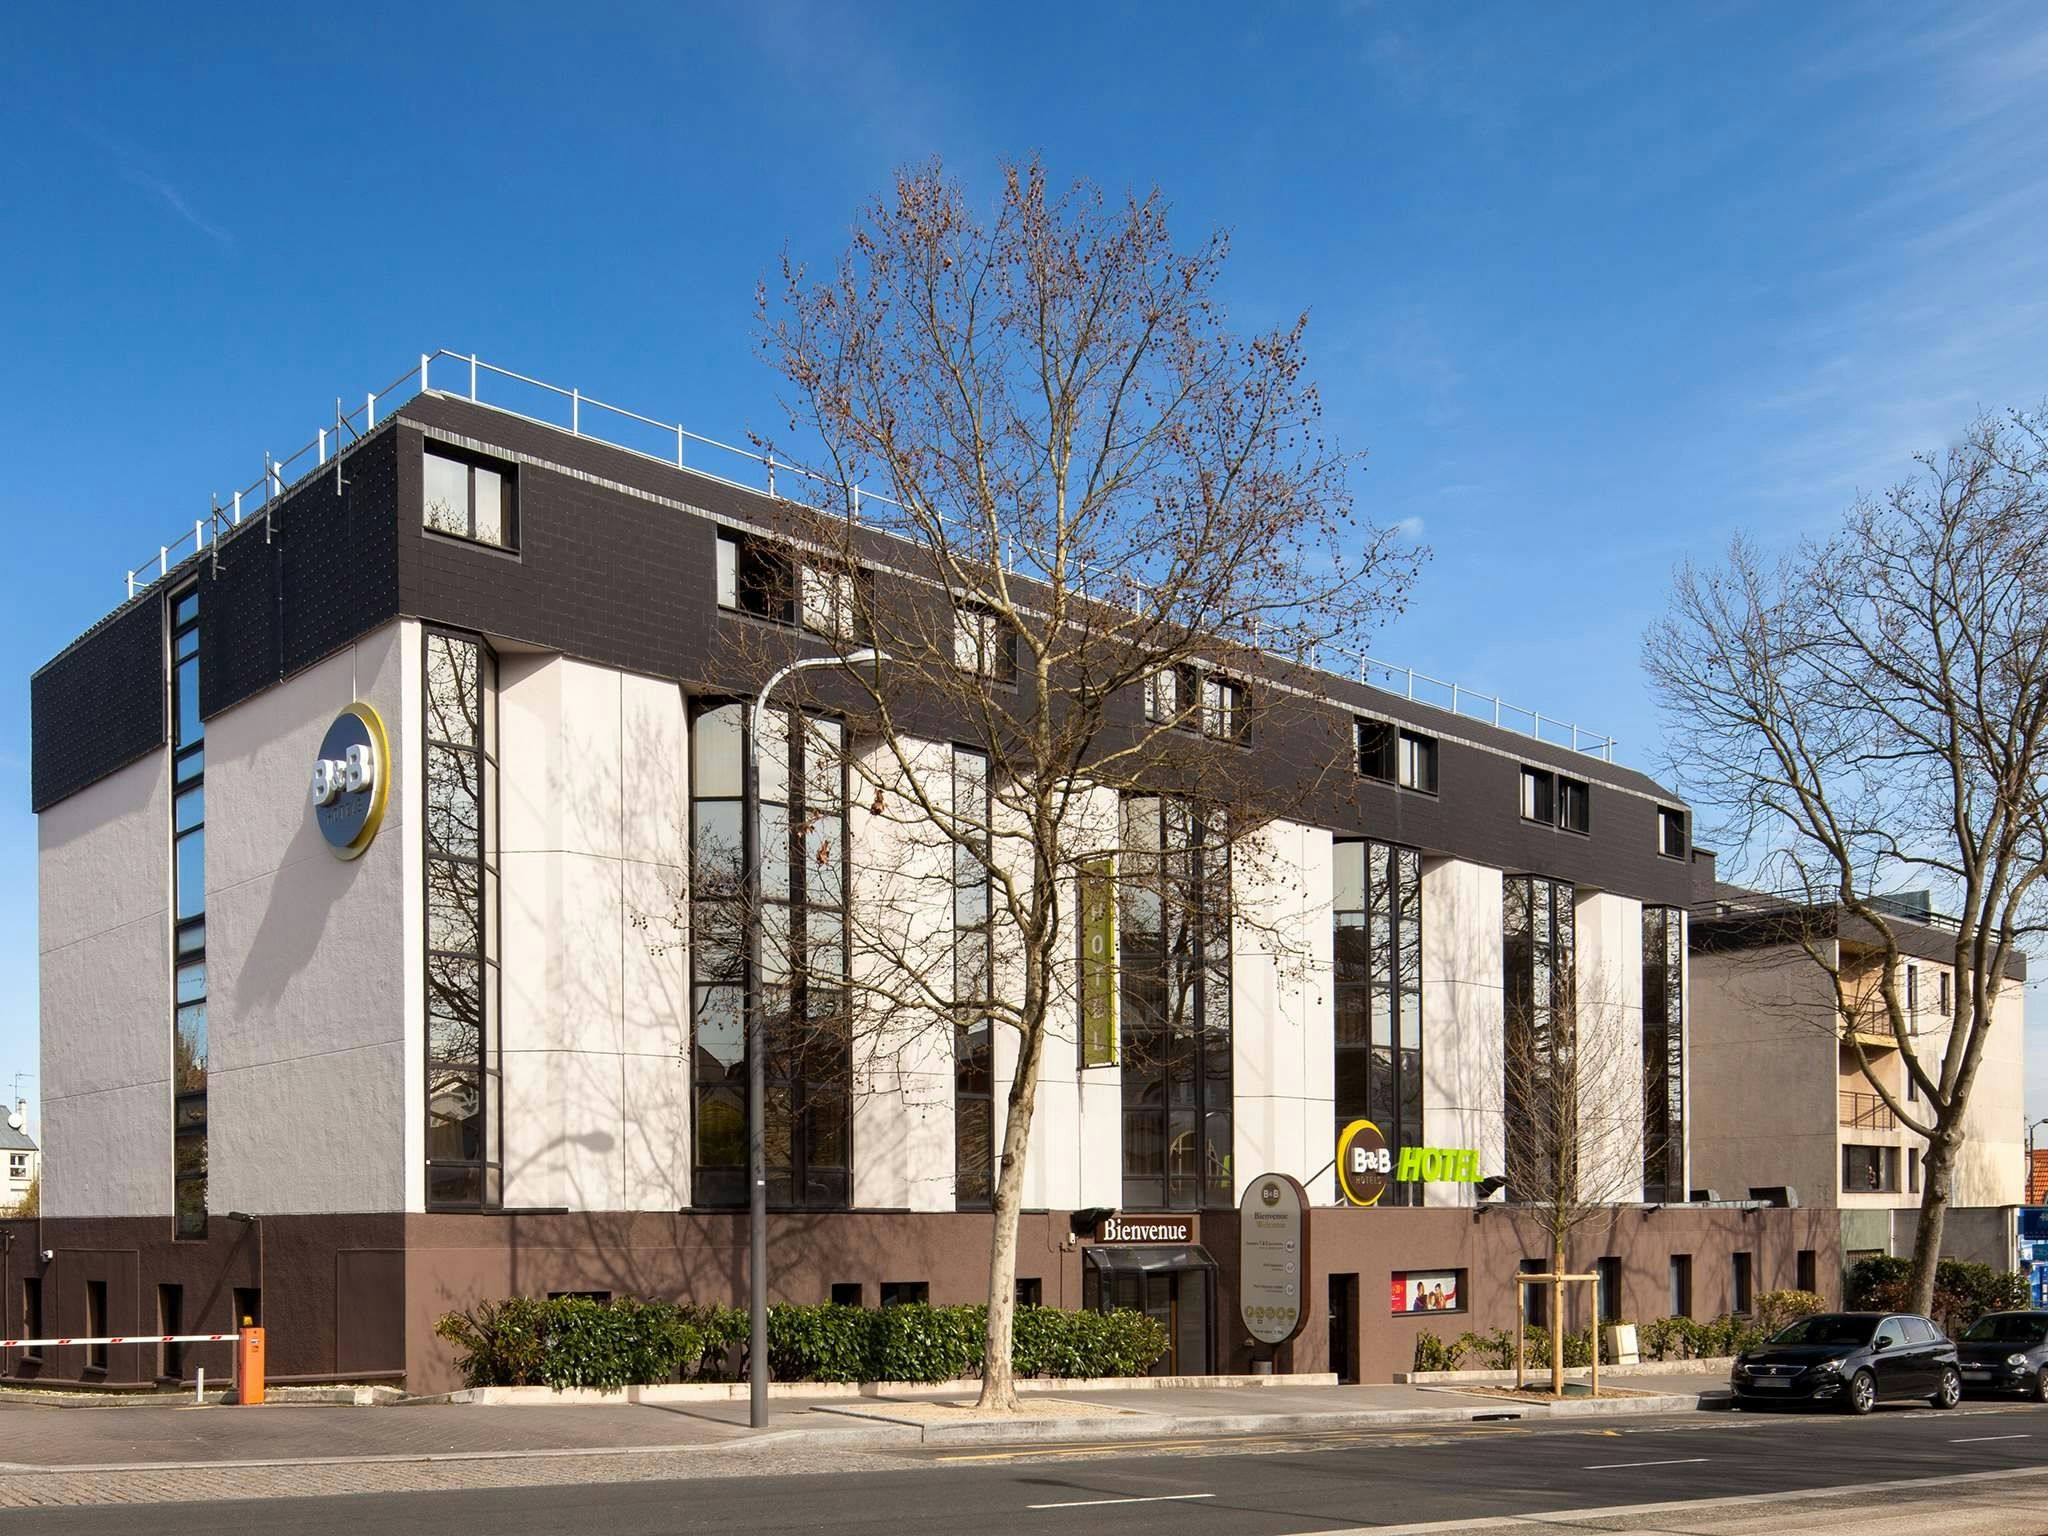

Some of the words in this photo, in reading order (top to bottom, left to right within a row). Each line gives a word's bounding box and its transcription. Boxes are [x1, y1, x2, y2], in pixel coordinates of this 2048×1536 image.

[313, 744, 371, 807] B&B
[1353, 1147, 1391, 1173] B&B
[1397, 1146, 1484, 1182] HOTEL
[1104, 1218, 1187, 1240] Bienvenue
